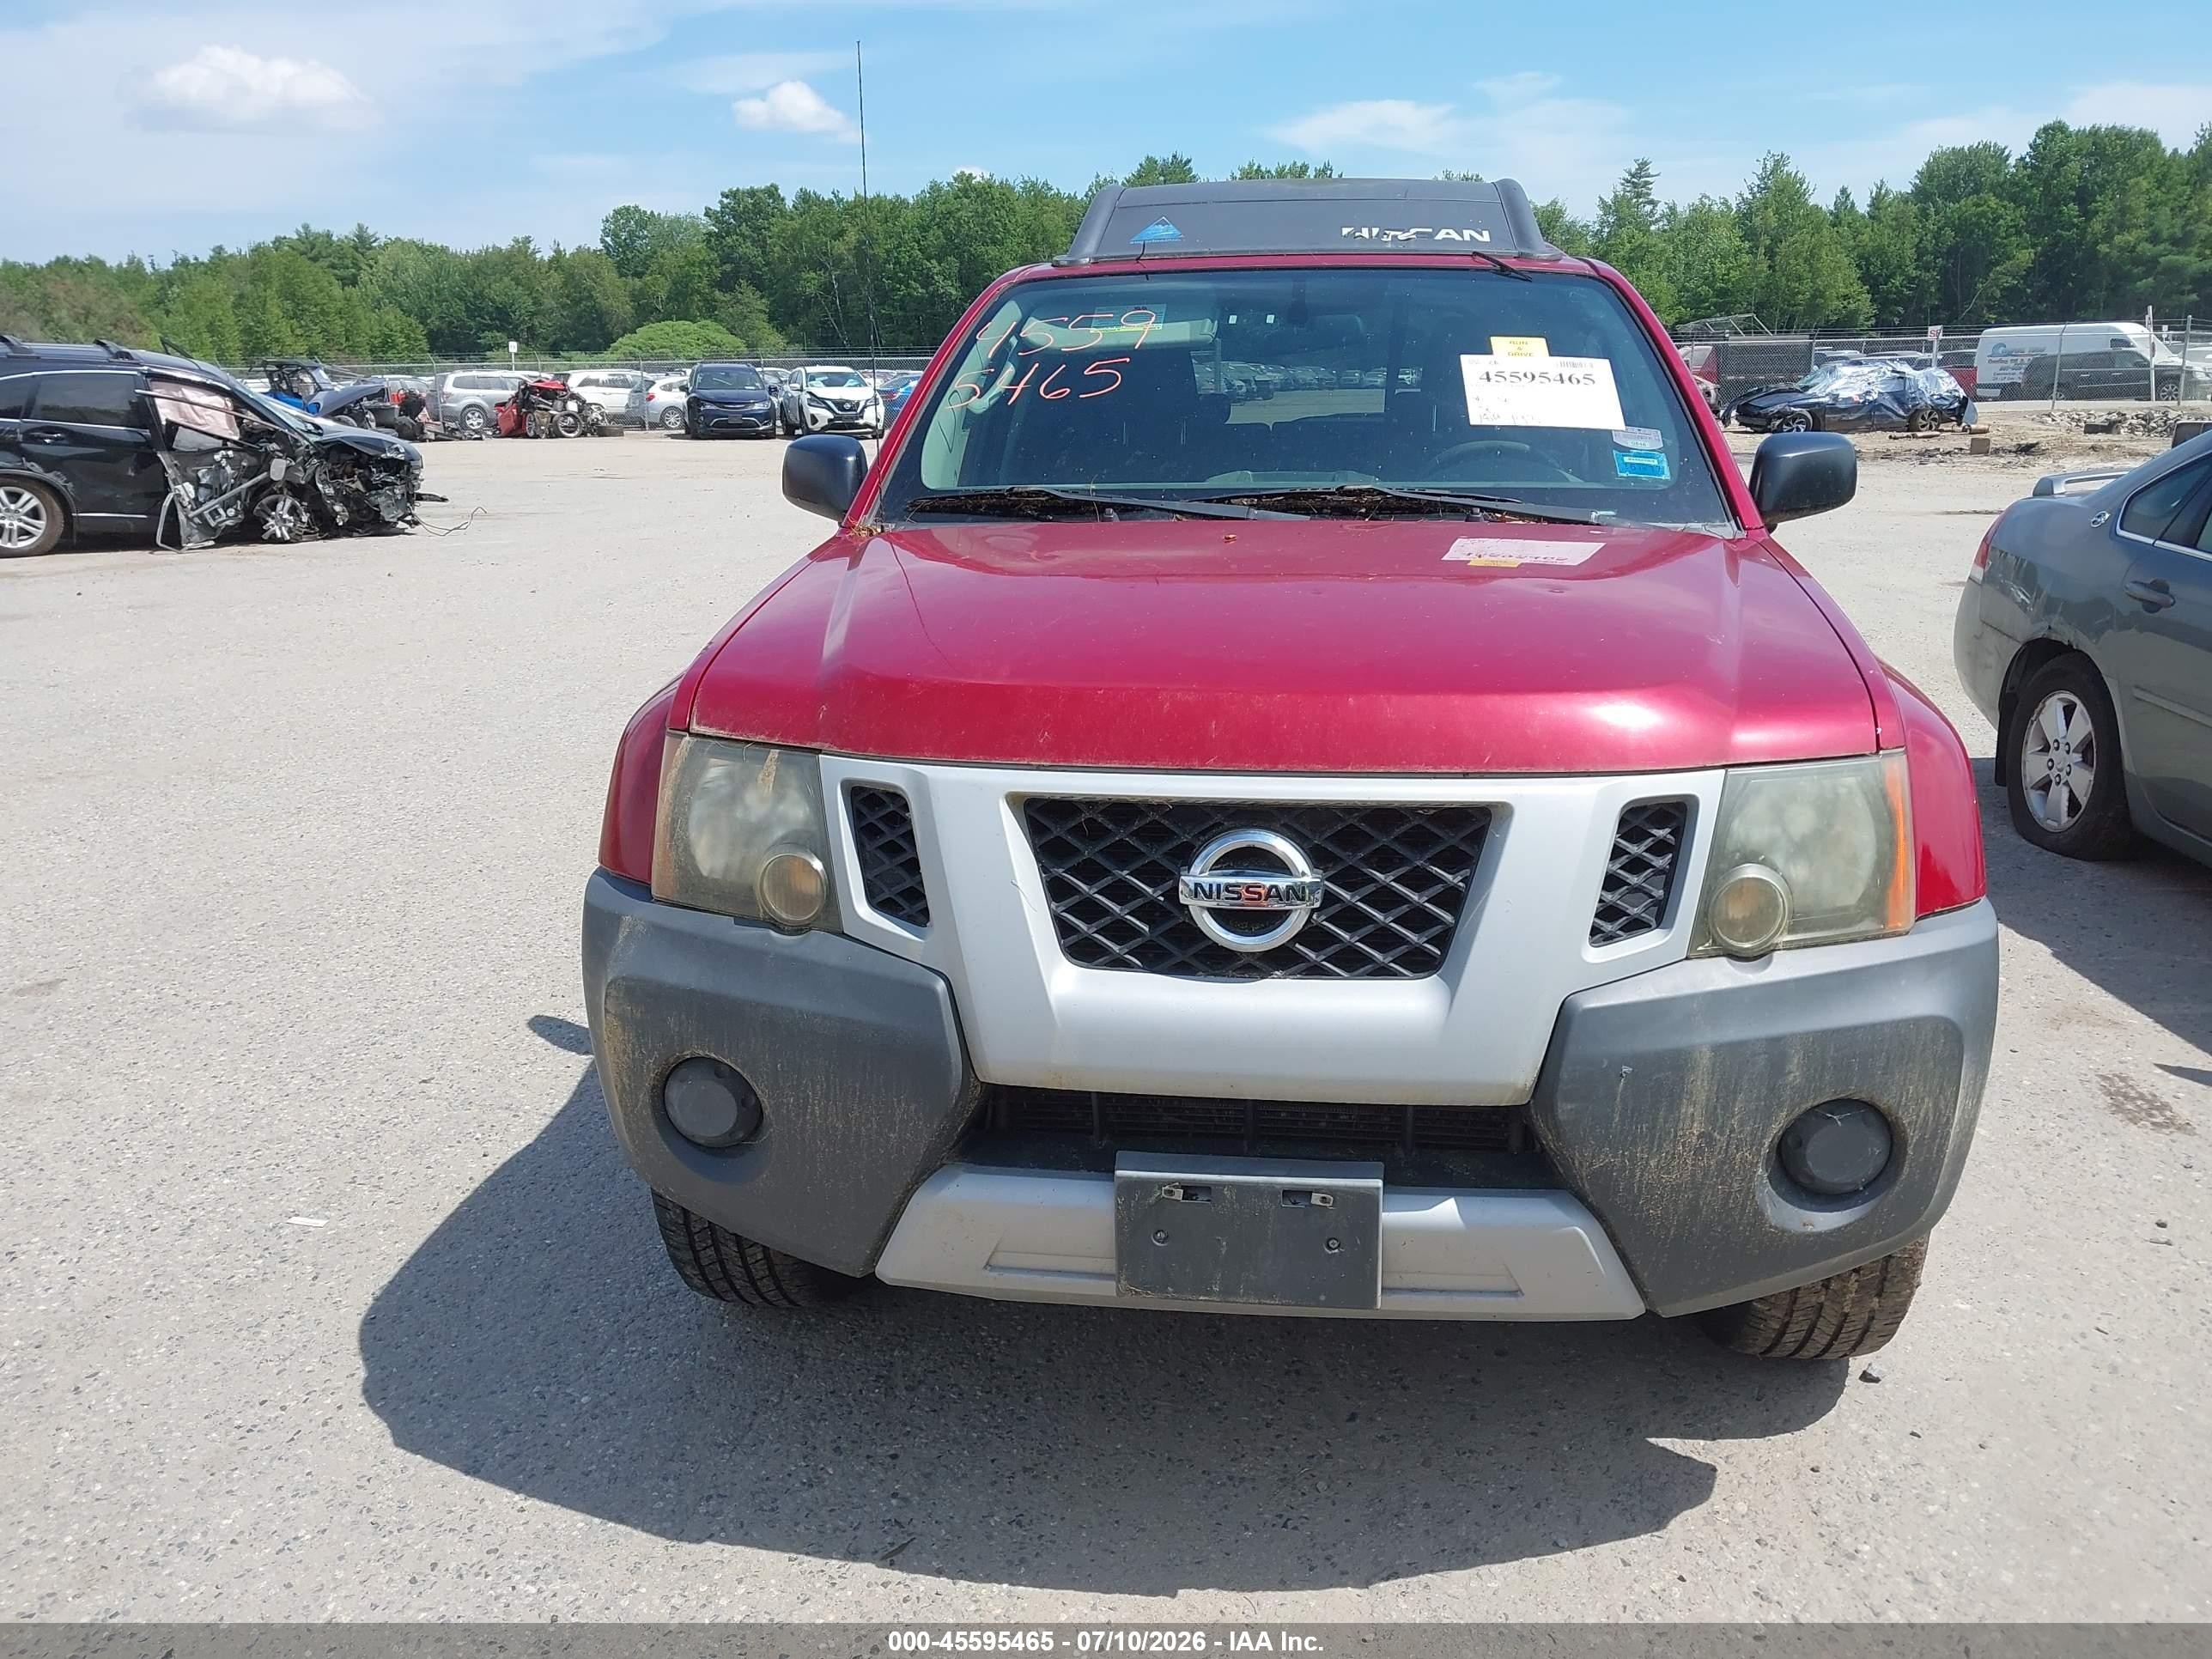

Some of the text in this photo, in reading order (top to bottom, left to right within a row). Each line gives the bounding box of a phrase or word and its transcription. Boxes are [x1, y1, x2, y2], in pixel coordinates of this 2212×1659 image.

[975, 310, 1156, 358] 4559
[945, 357, 1130, 409] 5465
[1479, 371, 1595, 386] 45595465
[1193, 882, 1306, 902] NISSAN
